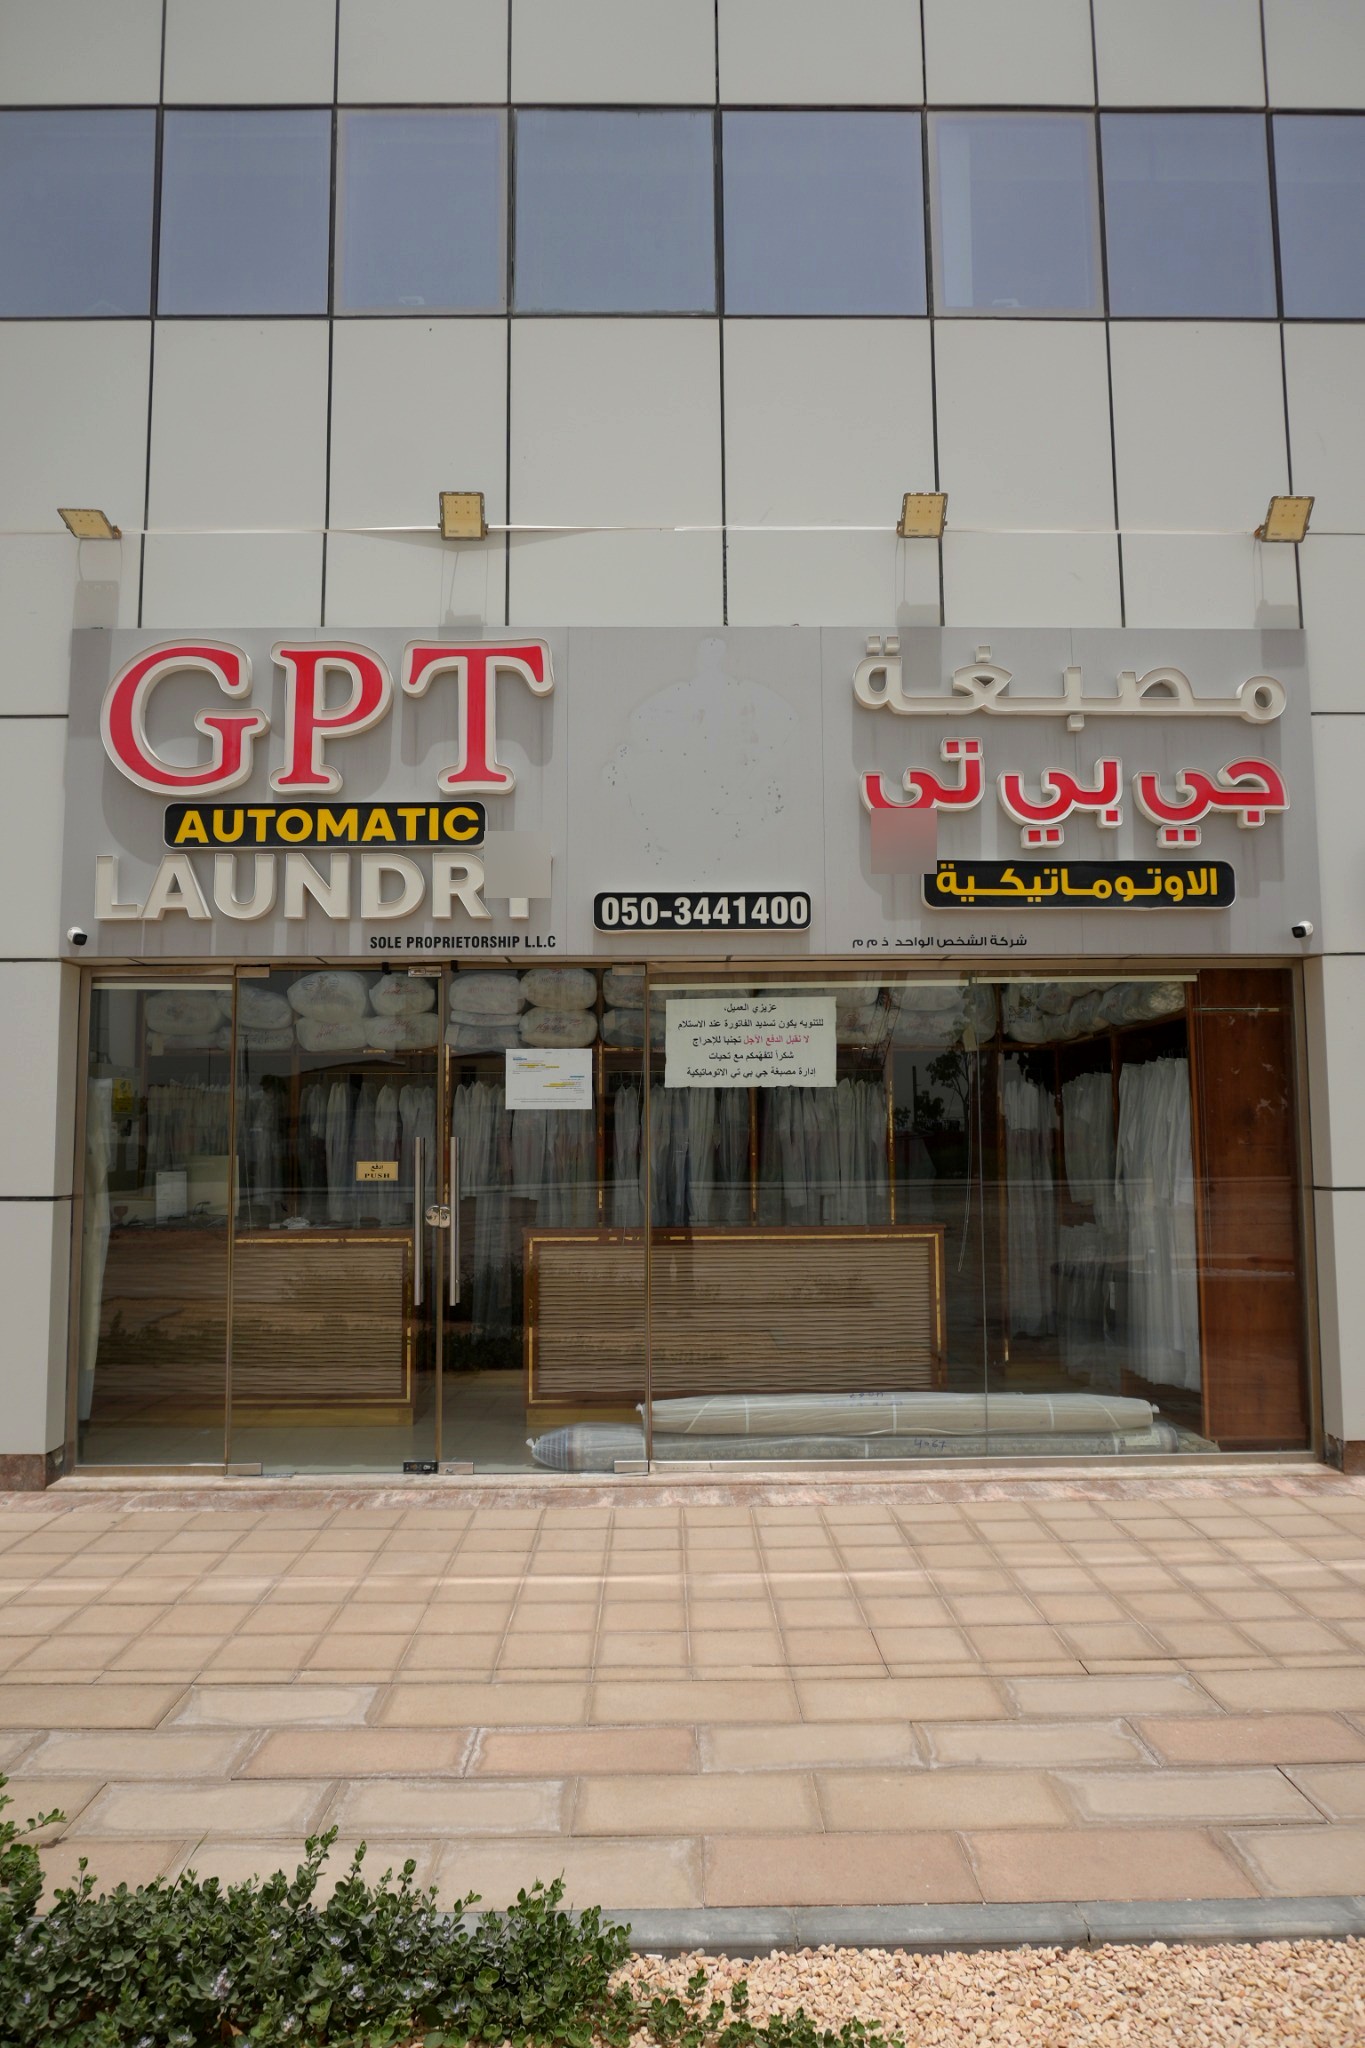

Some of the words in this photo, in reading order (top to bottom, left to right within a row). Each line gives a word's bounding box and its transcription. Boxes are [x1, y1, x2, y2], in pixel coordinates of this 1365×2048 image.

[853, 635, 1287, 731] مصبغة
[100, 638, 555, 795] GPT
[996, 755, 1122, 849] بي
[1132, 755, 1290, 849] جي
[174, 806, 480, 844] AUTOMATIC
[94, 852, 553, 920] LAUNDR
[936, 863, 1218, 903] الاوتوماتيكية
[601, 896, 808, 926] 050-3441400
[370, 936, 402, 949] SOLE
[406, 936, 520, 949] PROPRIETORSHIP
[525, 935, 556, 948] L.L.C
[852, 938, 864, 948] م
[867, 938, 878, 948] م
[895, 936, 934, 949] الواحد
[936, 934, 987, 948] الشخص
[990, 934, 1028, 948] شركة
[752, 1003, 777, 1013] عزيزي
[803, 1035, 810, 1044] لا
[733, 1053, 744, 1063] مع
